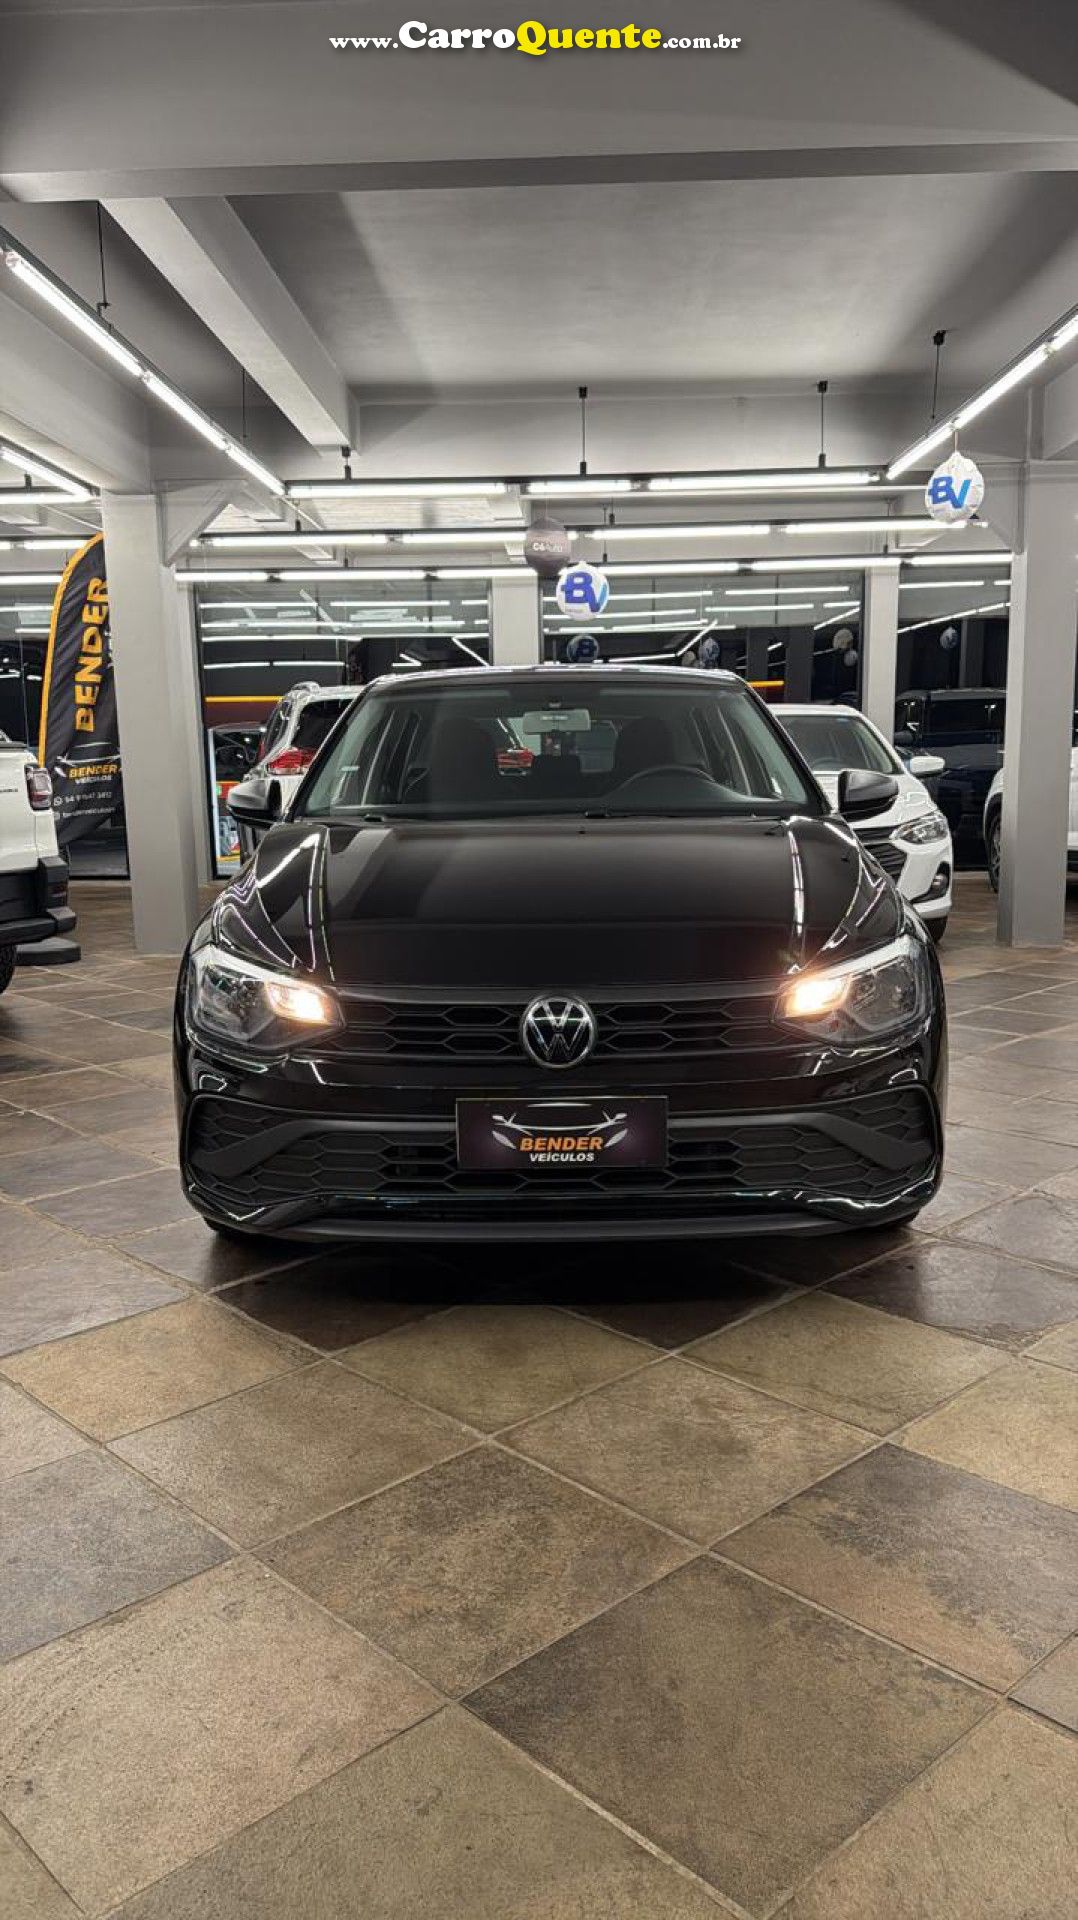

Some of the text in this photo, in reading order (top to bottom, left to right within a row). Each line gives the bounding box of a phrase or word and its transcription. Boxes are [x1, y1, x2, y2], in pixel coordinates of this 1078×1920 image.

[928, 476, 972, 509] BV
[561, 572, 608, 613] BV
[74, 577, 109, 733] BENDER
[69, 764, 118, 778] BENDER
[519, 1136, 604, 1151] BENDER
[529, 1152, 595, 1162] VEÍCULOS
